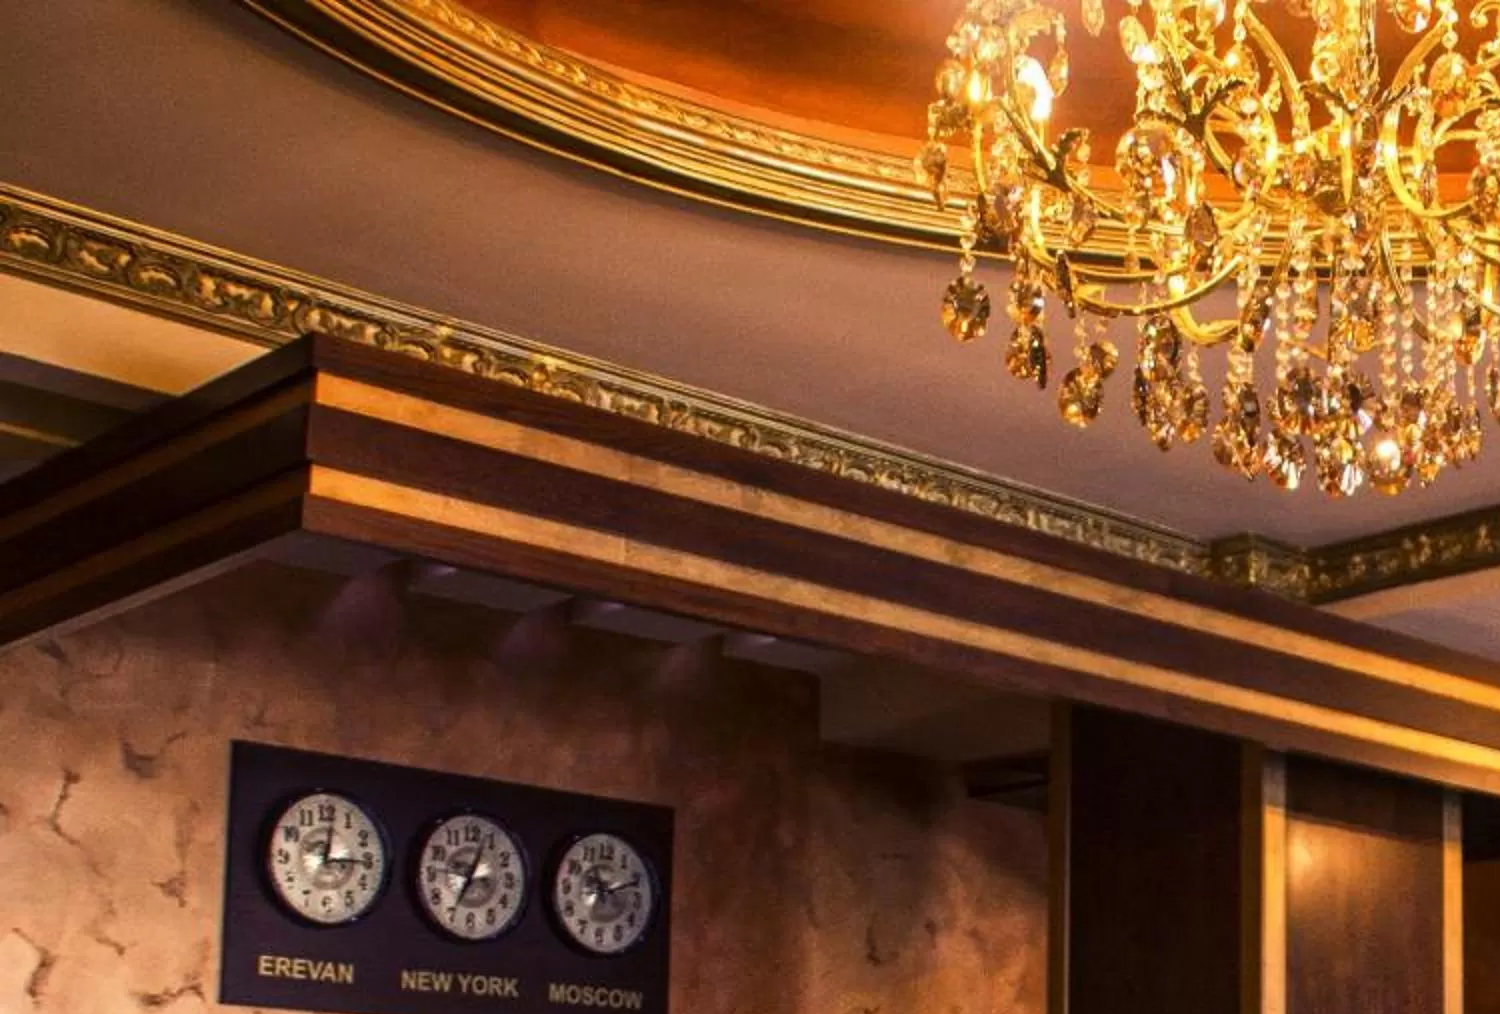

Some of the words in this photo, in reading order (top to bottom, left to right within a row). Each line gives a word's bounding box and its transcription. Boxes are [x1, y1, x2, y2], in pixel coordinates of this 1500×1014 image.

[299, 809, 314, 827] 11
[318, 804, 336, 822] 12
[344, 812, 353, 829] 1
[283, 825, 299, 843] 10
[446, 829, 460, 846] 11
[464, 824, 481, 842] 12
[258, 954, 355, 985] EREVAN
[400, 969, 453, 993] NEW
[456, 972, 521, 998] YORK
[548, 982, 644, 1010] MOSCOW
